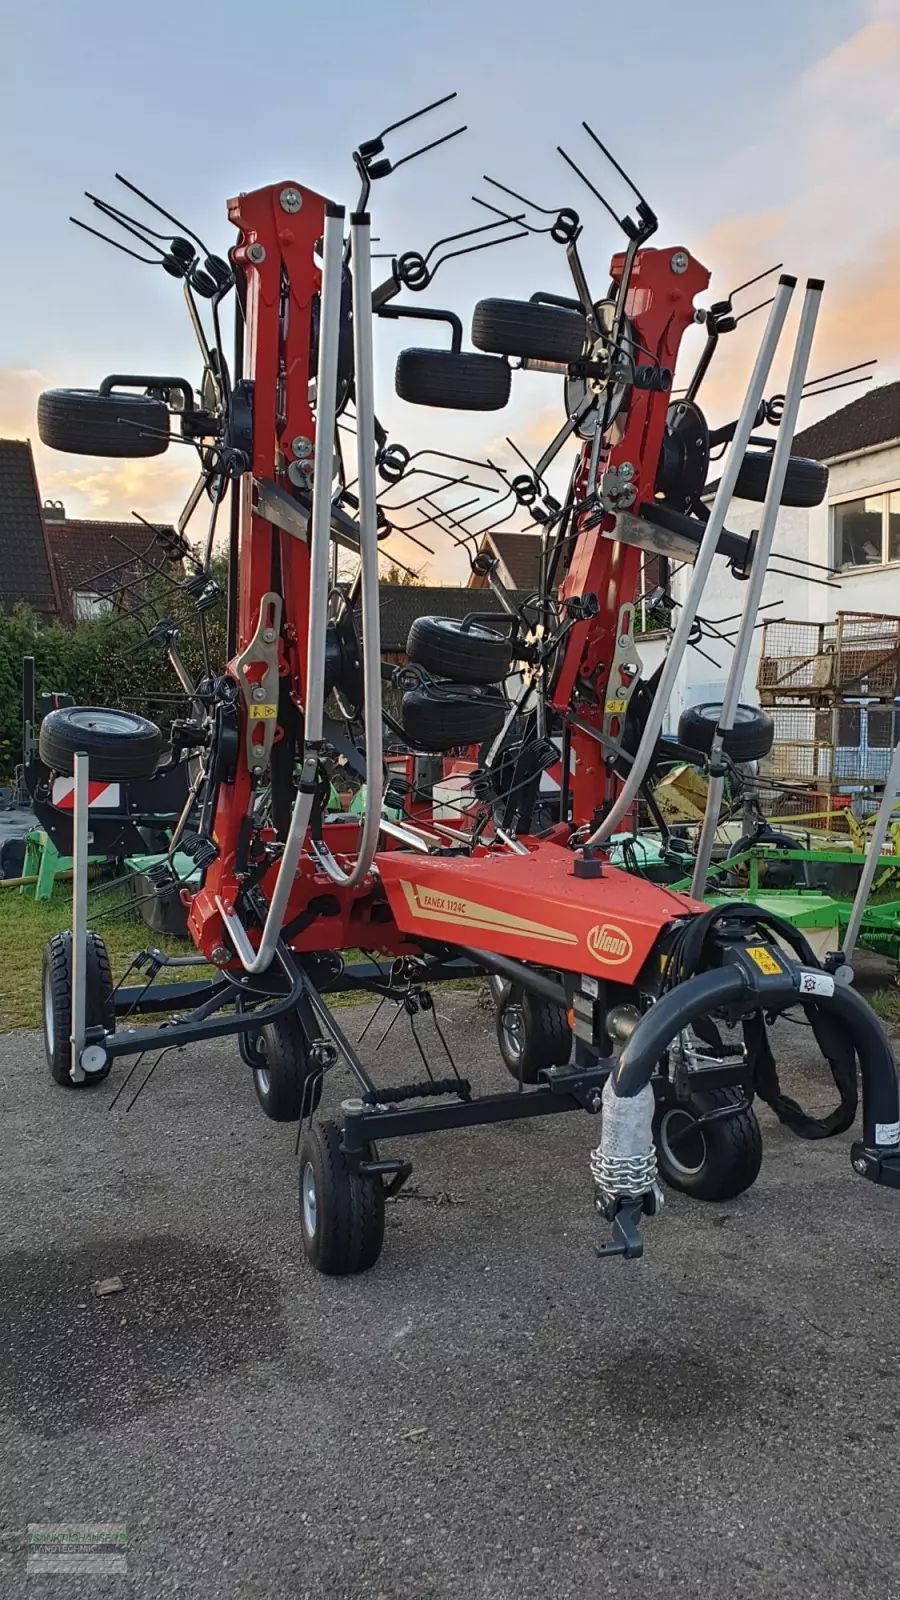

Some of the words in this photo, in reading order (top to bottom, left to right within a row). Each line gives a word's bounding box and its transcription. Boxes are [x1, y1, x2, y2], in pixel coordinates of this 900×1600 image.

[424, 895, 445, 909] FANEX
[447, 900, 466, 914] 1124C
[591, 925, 628, 957] Vicon
